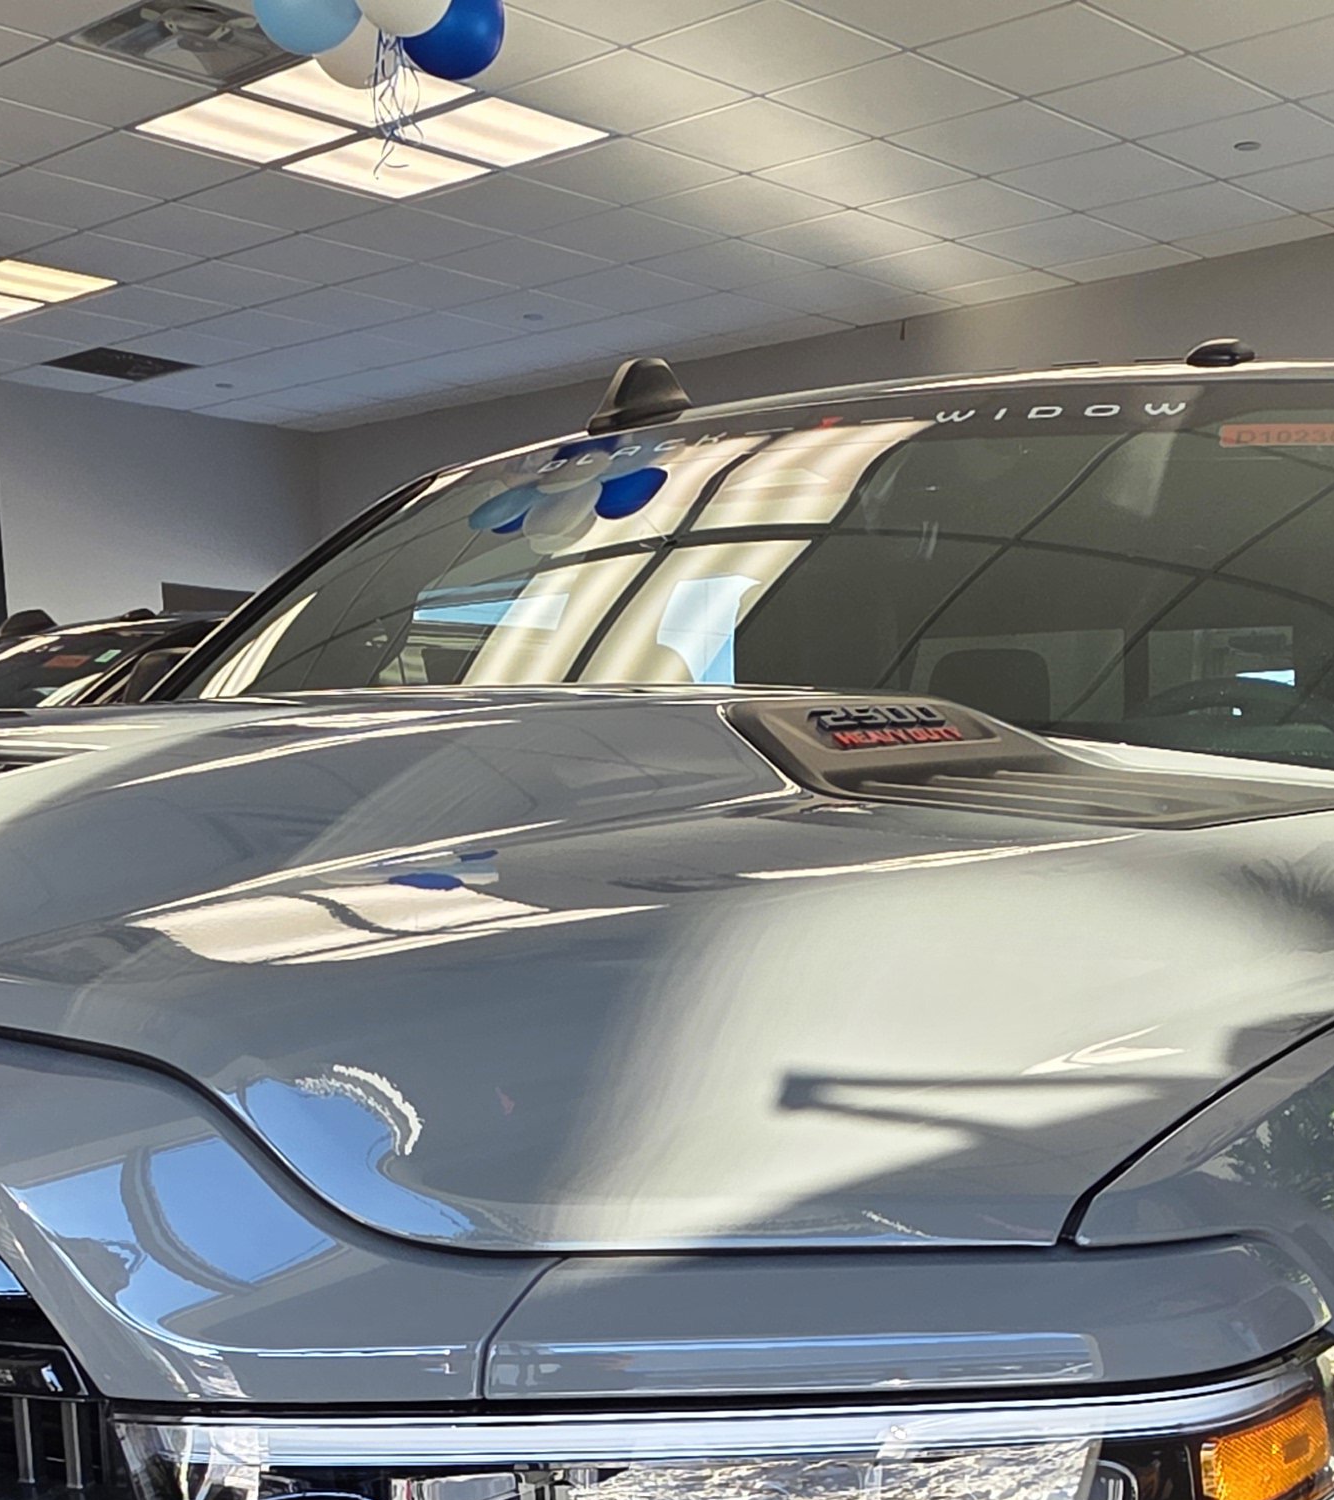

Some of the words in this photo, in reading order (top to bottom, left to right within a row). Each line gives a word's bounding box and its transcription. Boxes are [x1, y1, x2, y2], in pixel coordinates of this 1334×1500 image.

[536, 432, 727, 475] BLACK
[935, 401, 1187, 423] WIDOW
[806, 704, 945, 732] 2500
[833, 728, 910, 749] HEAVY
[910, 725, 964, 744] DUTY
